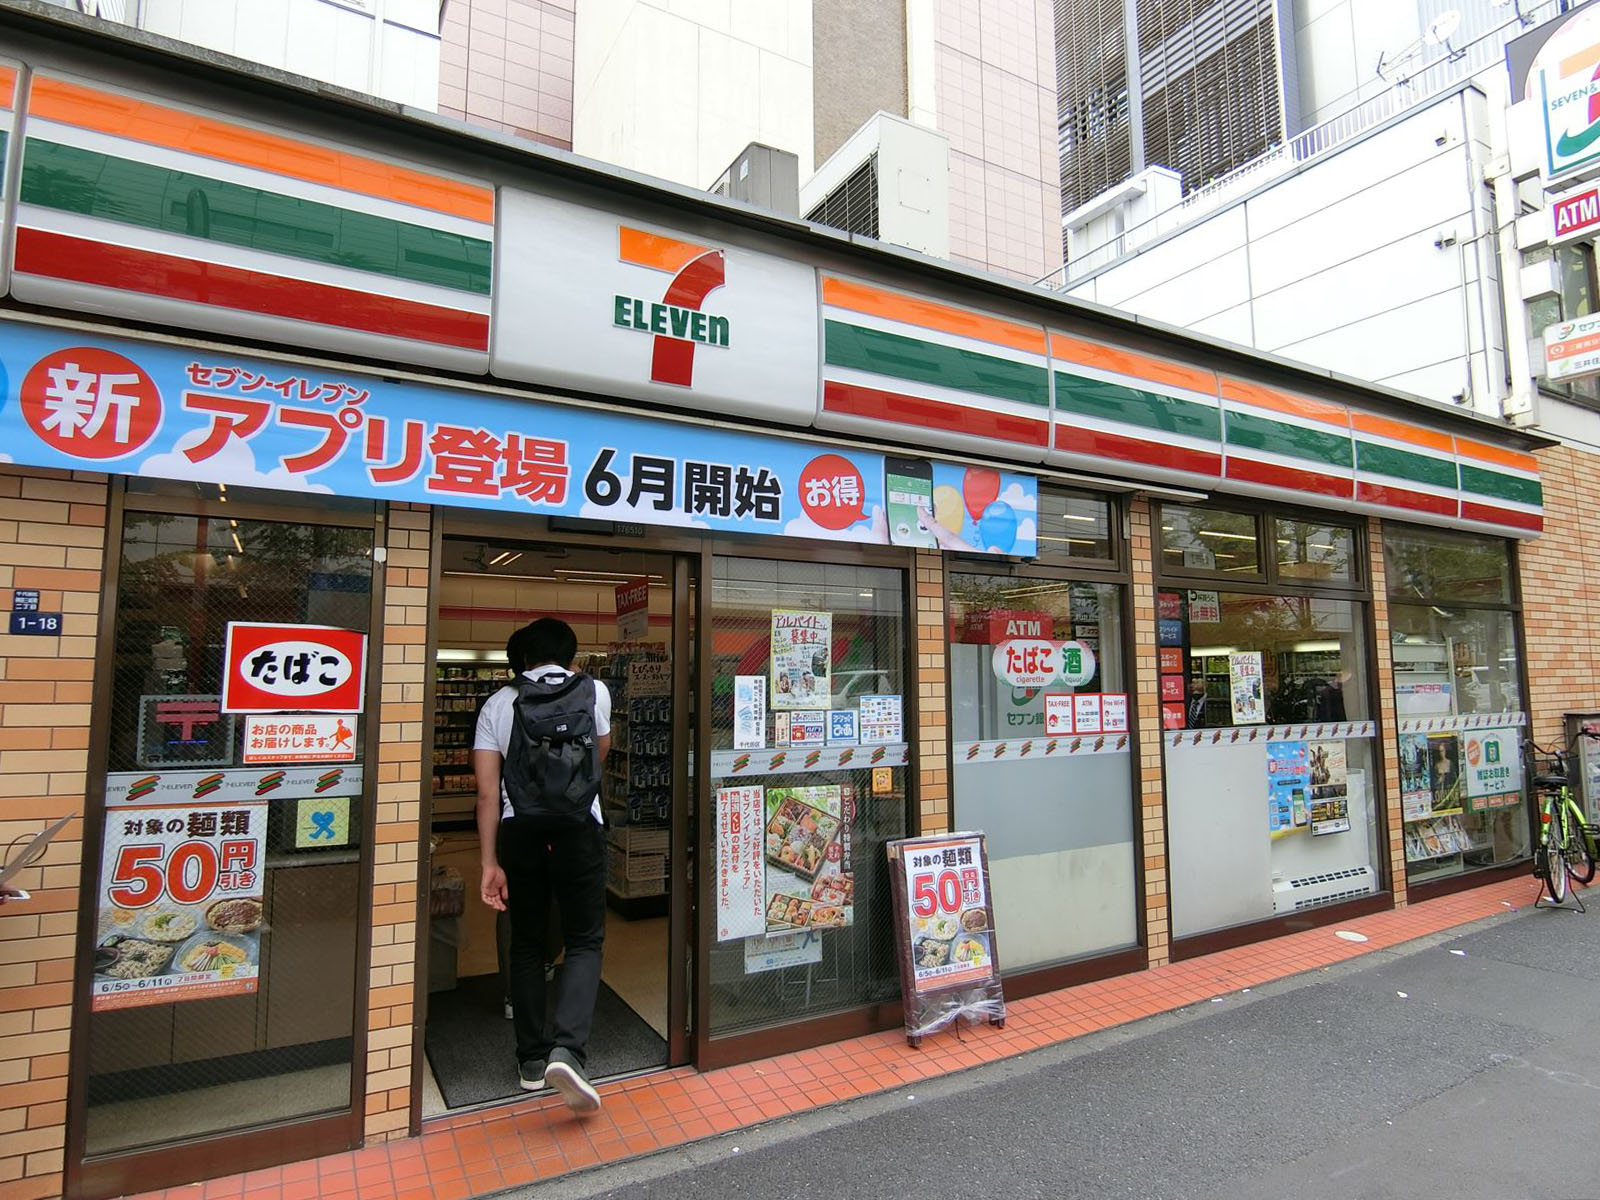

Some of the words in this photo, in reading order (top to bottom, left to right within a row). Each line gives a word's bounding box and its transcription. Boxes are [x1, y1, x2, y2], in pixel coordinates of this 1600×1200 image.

[1557, 195, 1599, 231] ATM
[41, 362, 141, 444] 新
[182, 392, 570, 504] アプリ登場
[584, 448, 782, 521] 6月開始
[804, 475, 861, 508] お得
[616, 584, 647, 610] TAX-FREE
[19, 617, 57, 630] 1-18
[1005, 620, 1041, 636] ATM
[251, 650, 341, 686] たばこ
[1006, 646, 1054, 674] たばこ
[1063, 648, 1082, 674] 酒
[1016, 675, 1045, 684] cigarette
[252, 724, 317, 735] お店の商品
[251, 737, 330, 749] お届けします。
[1484, 780, 1506, 791] サービス
[124, 810, 251, 837] 対象の麺類
[913, 847, 973, 868] 対象の麺類
